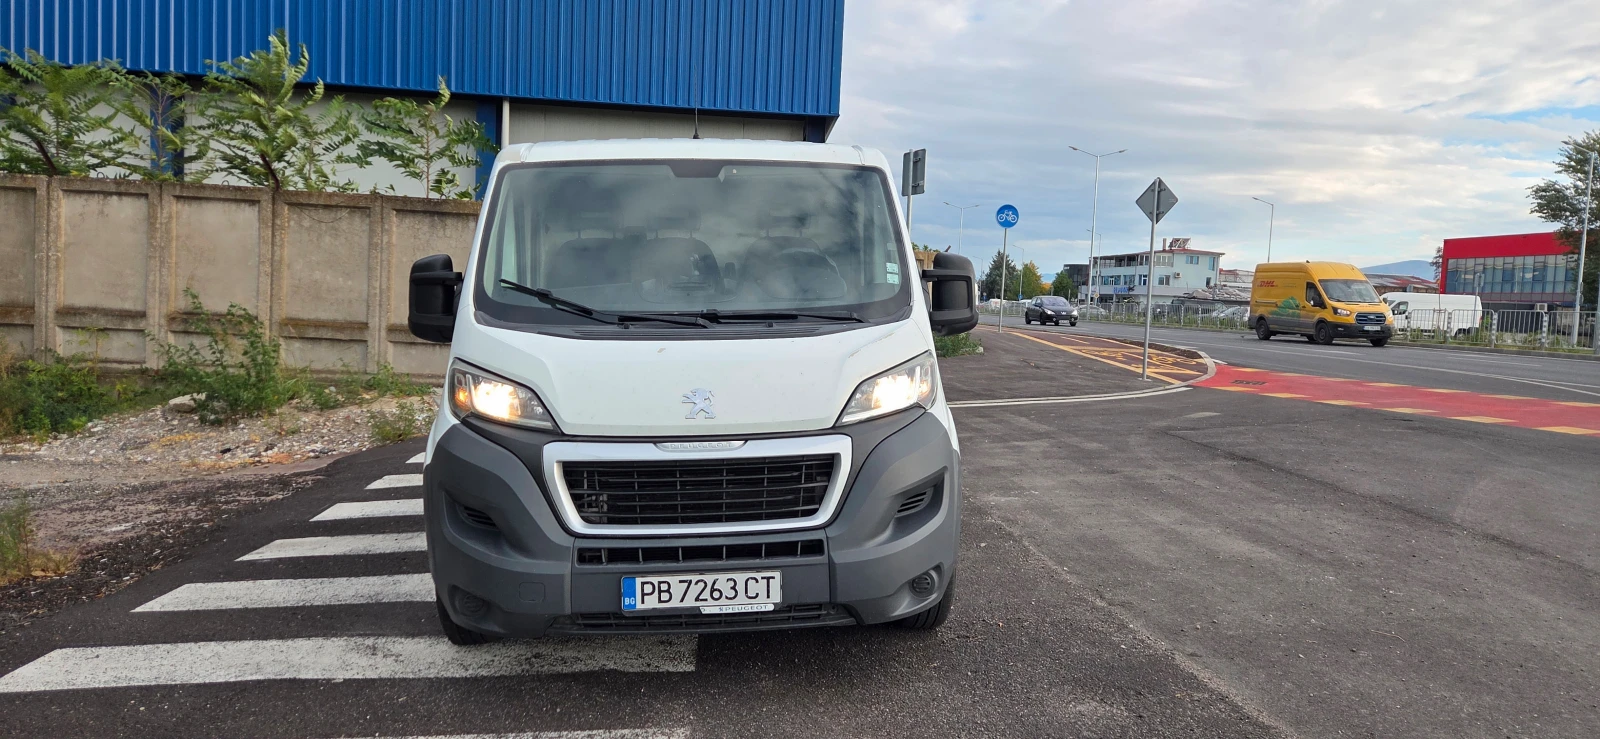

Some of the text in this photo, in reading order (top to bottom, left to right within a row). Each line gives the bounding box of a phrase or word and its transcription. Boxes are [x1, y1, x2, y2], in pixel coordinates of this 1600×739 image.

[640, 576, 776, 605] PB 7263 CT
[624, 597, 636, 605] BG
[725, 604, 768, 612] PEUGEOT
